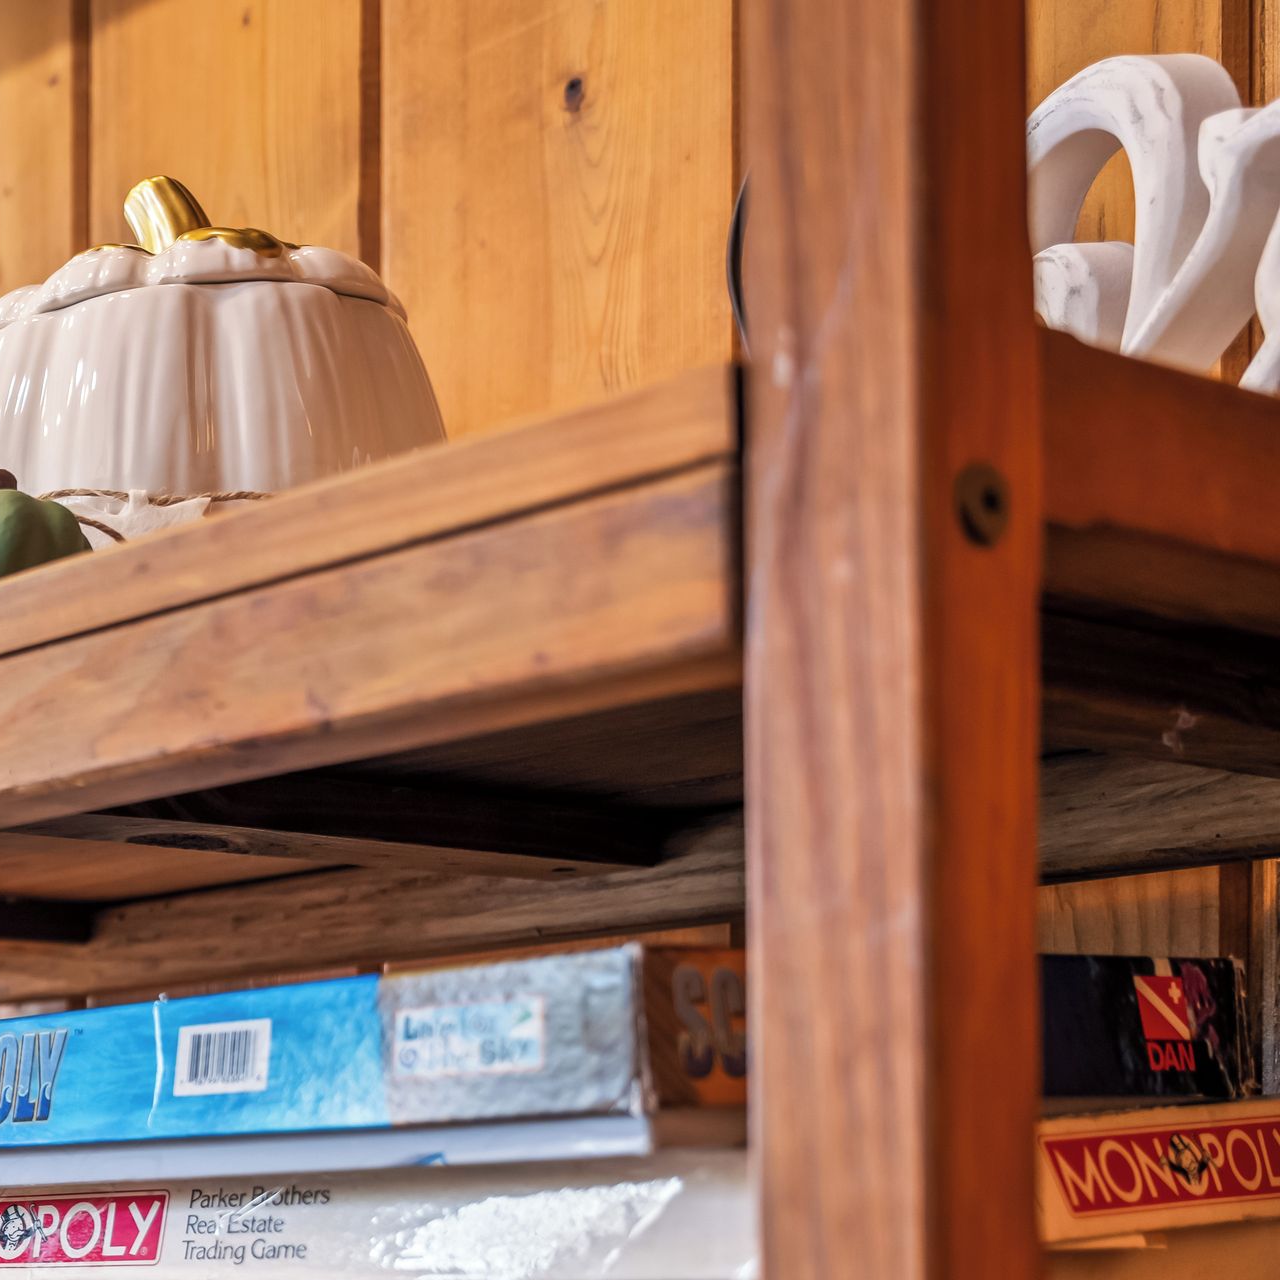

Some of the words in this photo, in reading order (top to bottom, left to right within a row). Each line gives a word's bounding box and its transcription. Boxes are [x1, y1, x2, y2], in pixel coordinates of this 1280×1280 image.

[1147, 1042, 1196, 1072] DAN
[1054, 1128, 1280, 1207] MONOPOL
[189, 1188, 247, 1208] Parker
[227, 1214, 285, 1234] Estate
[182, 1240, 246, 1265] Trading
[251, 1239, 307, 1260] Game
